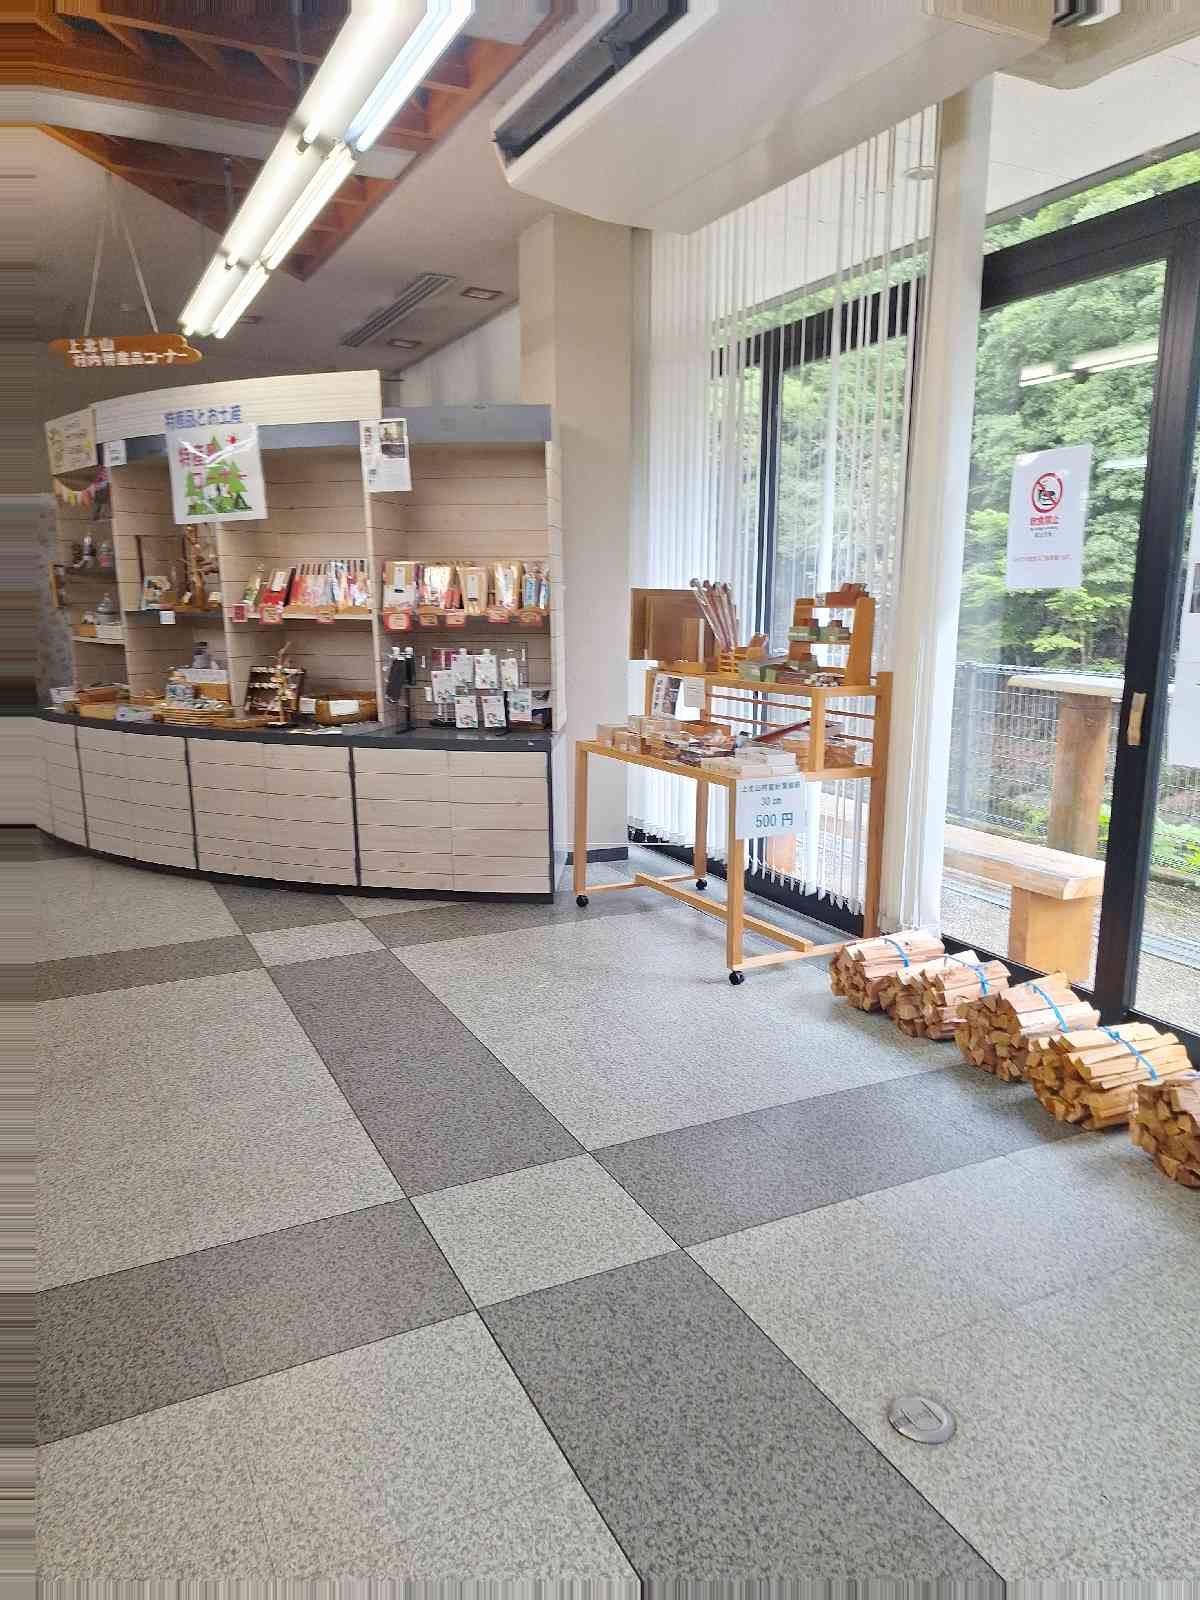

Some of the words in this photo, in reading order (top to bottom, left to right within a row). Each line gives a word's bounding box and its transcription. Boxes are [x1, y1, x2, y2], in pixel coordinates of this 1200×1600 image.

[68, 337, 115, 354] 上北山
[755, 813, 777, 828] 500
[782, 812, 794, 827] 円
